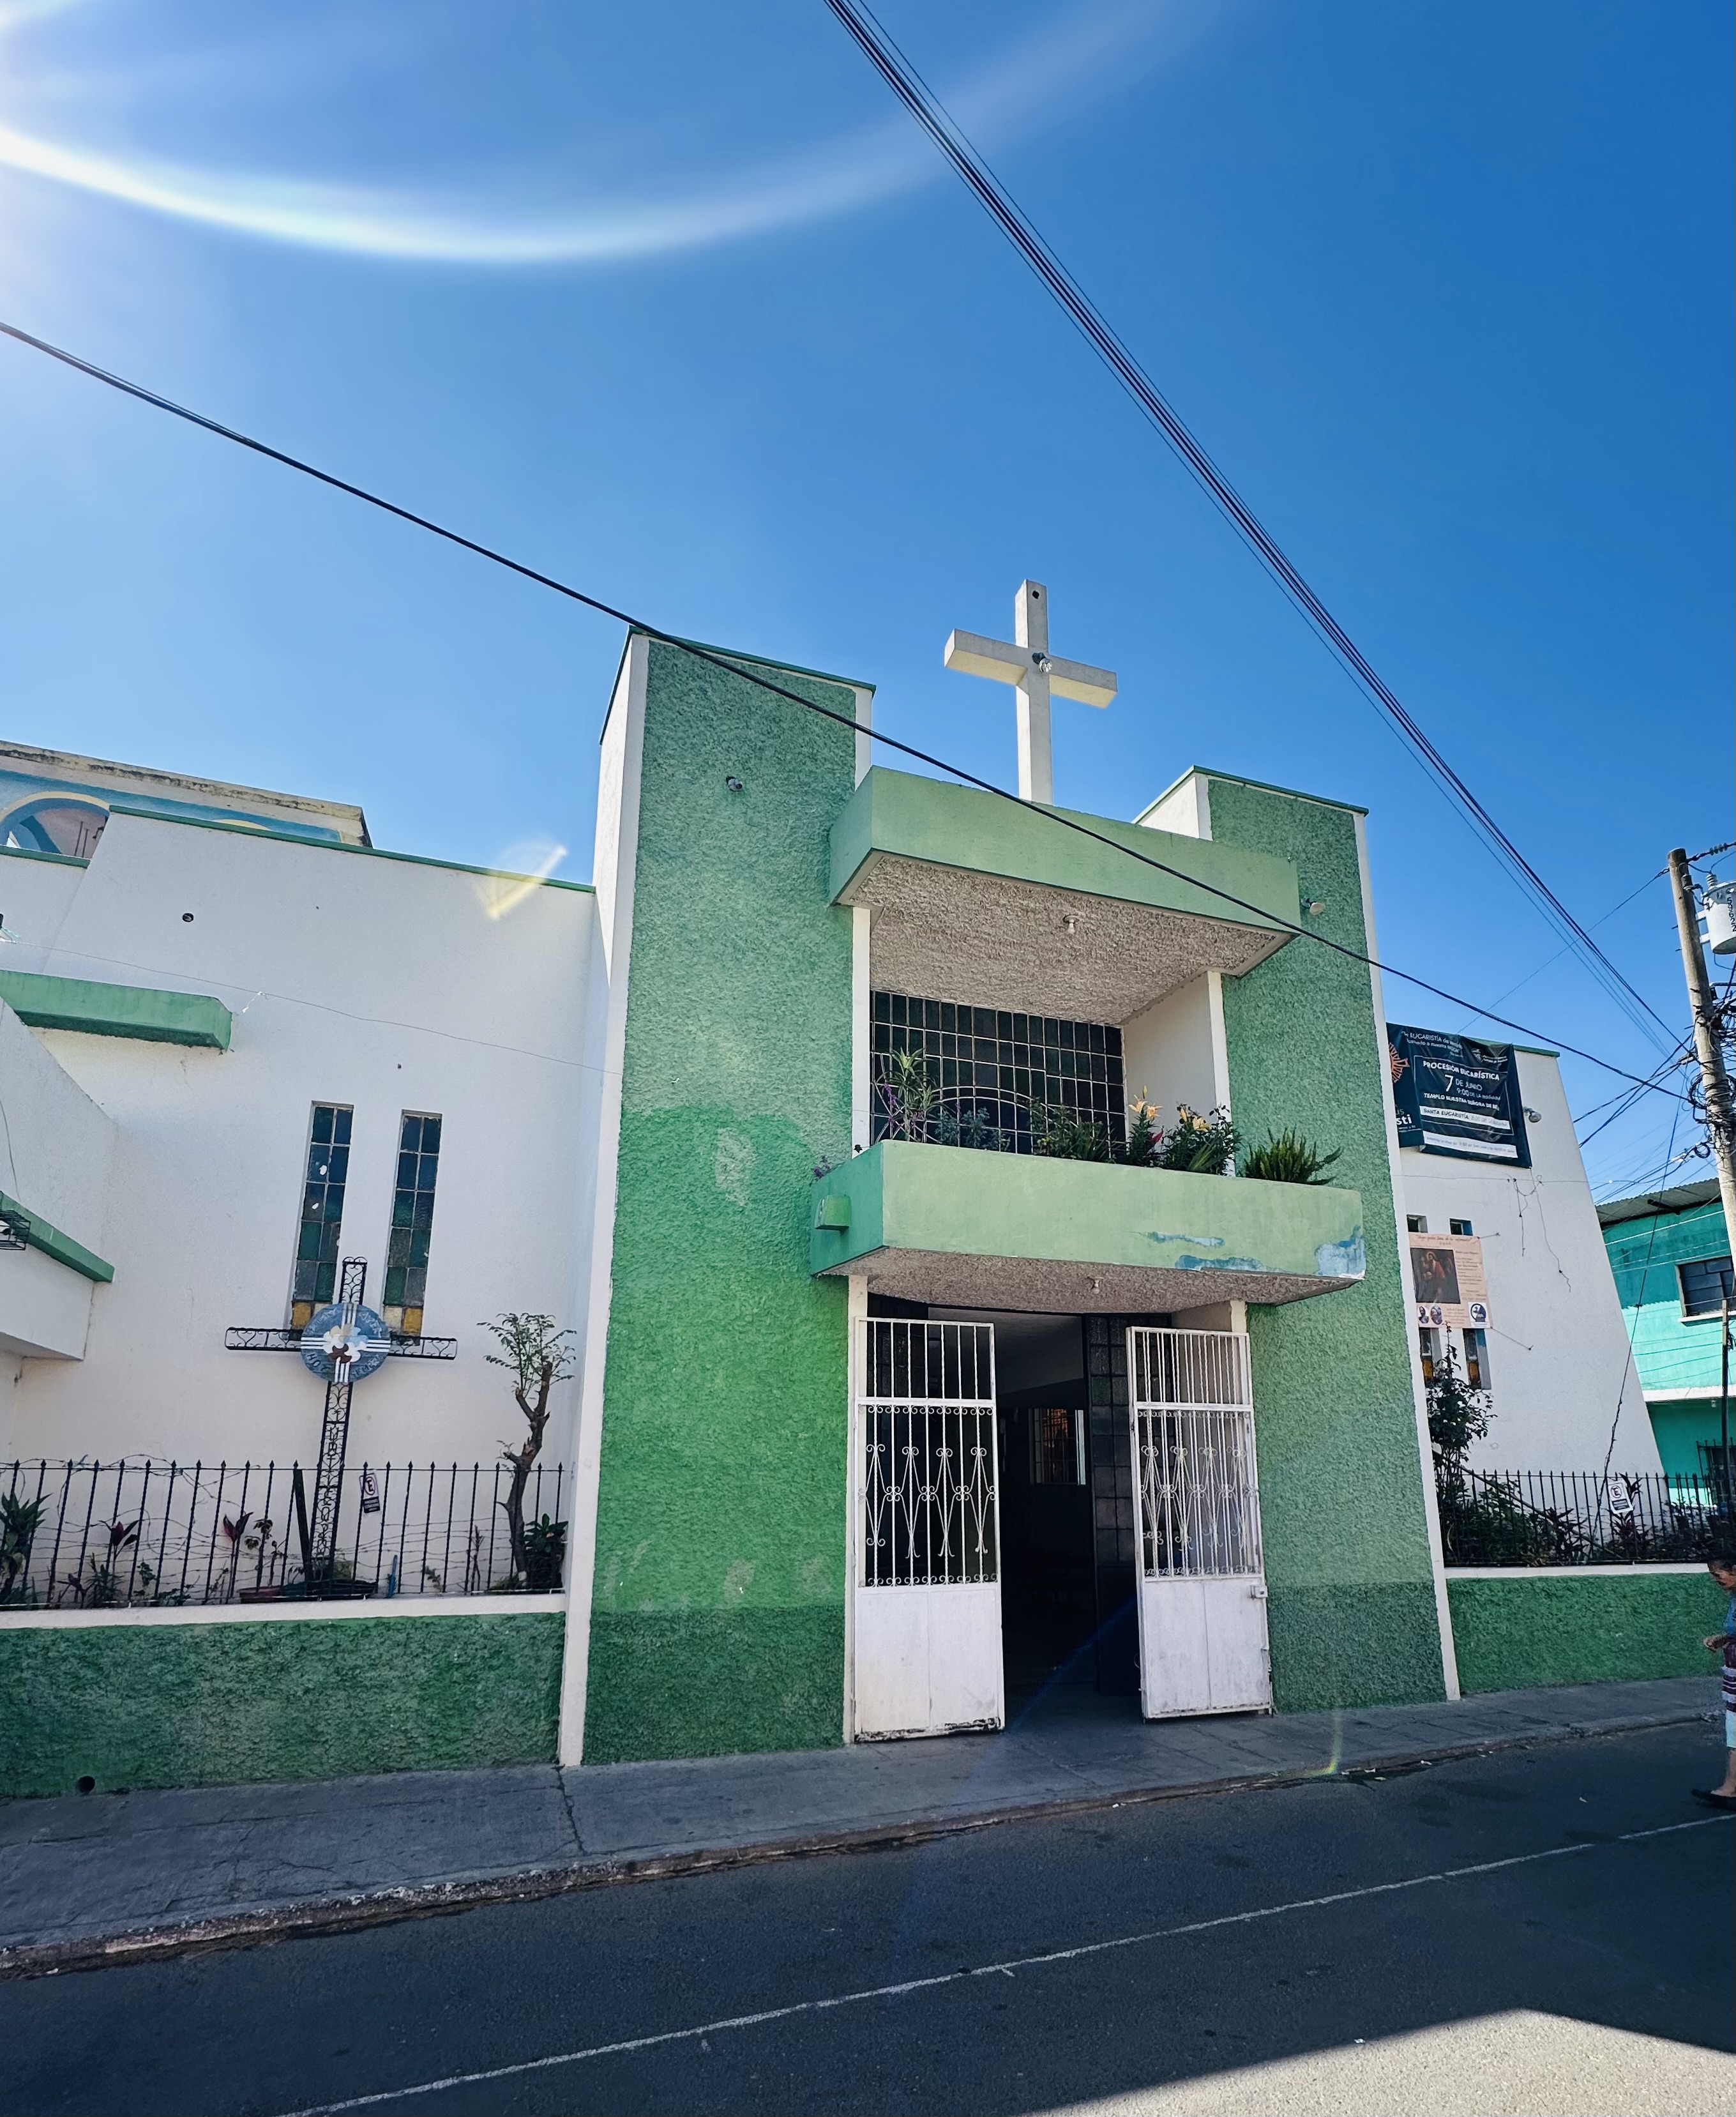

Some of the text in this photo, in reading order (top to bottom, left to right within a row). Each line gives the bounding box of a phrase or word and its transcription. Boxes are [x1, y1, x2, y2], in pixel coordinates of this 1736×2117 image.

[1423, 1061, 1500, 1081] PROCESIÓN EUCARÍSTICA
[1444, 1074, 1454, 1092] 7
[1456, 1079, 1464, 1087] DE
